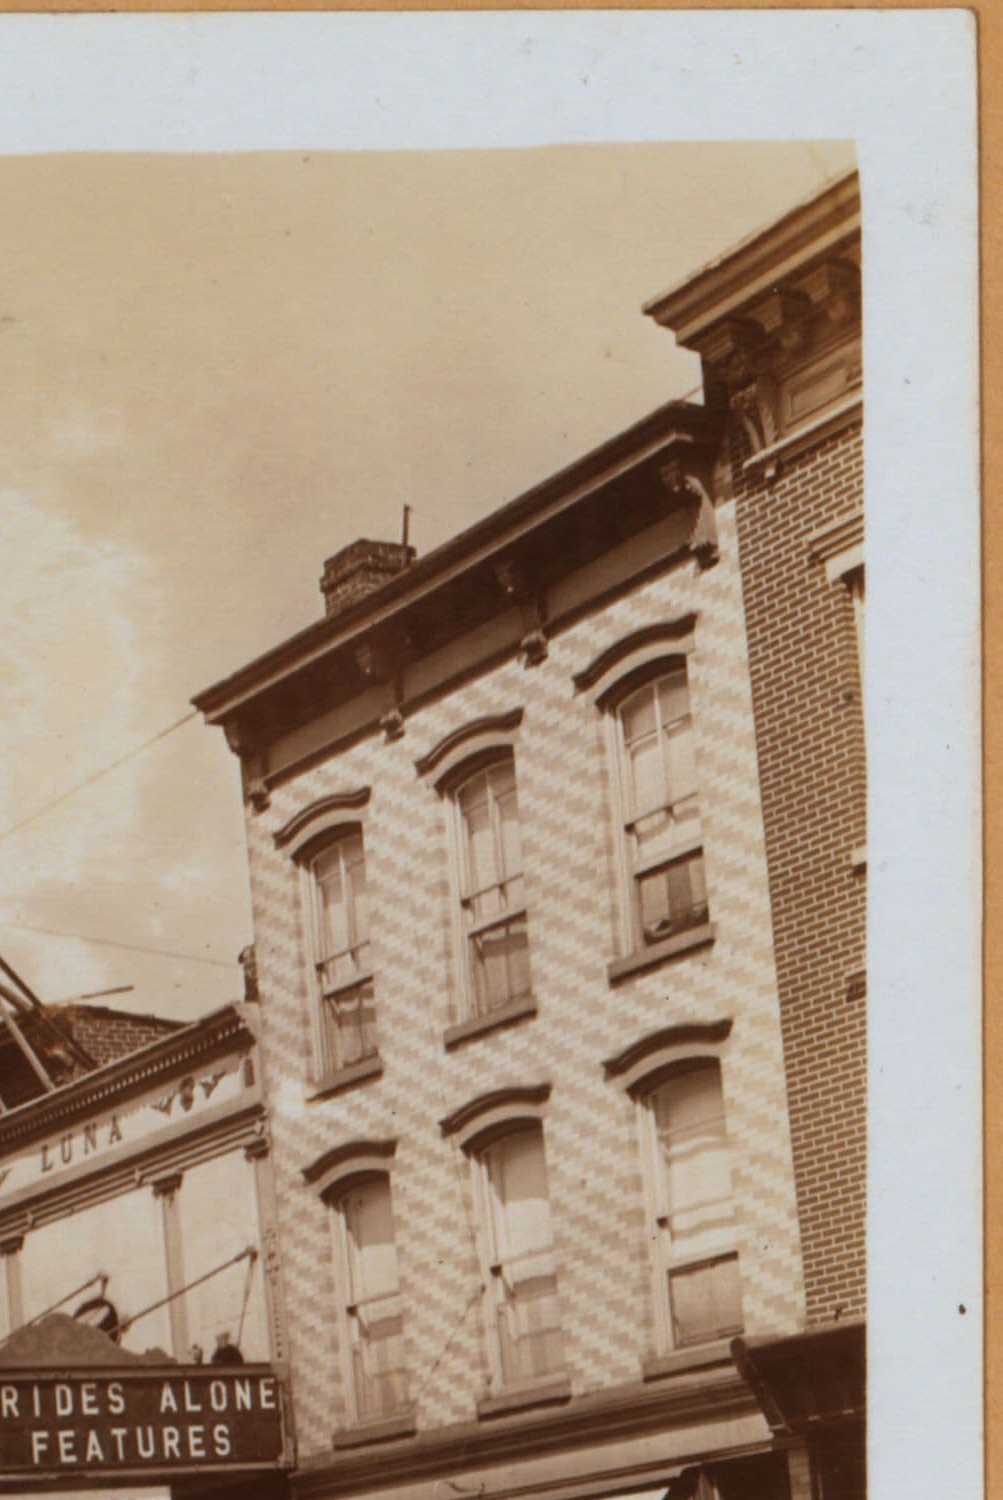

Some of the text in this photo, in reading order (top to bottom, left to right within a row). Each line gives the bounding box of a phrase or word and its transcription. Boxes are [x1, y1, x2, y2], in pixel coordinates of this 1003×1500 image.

[38, 1113, 124, 1173] LUNA
[1, 1382, 125, 1419] RIDES
[160, 1378, 277, 1413] ALONE
[31, 1425, 232, 1464] FEATURES
